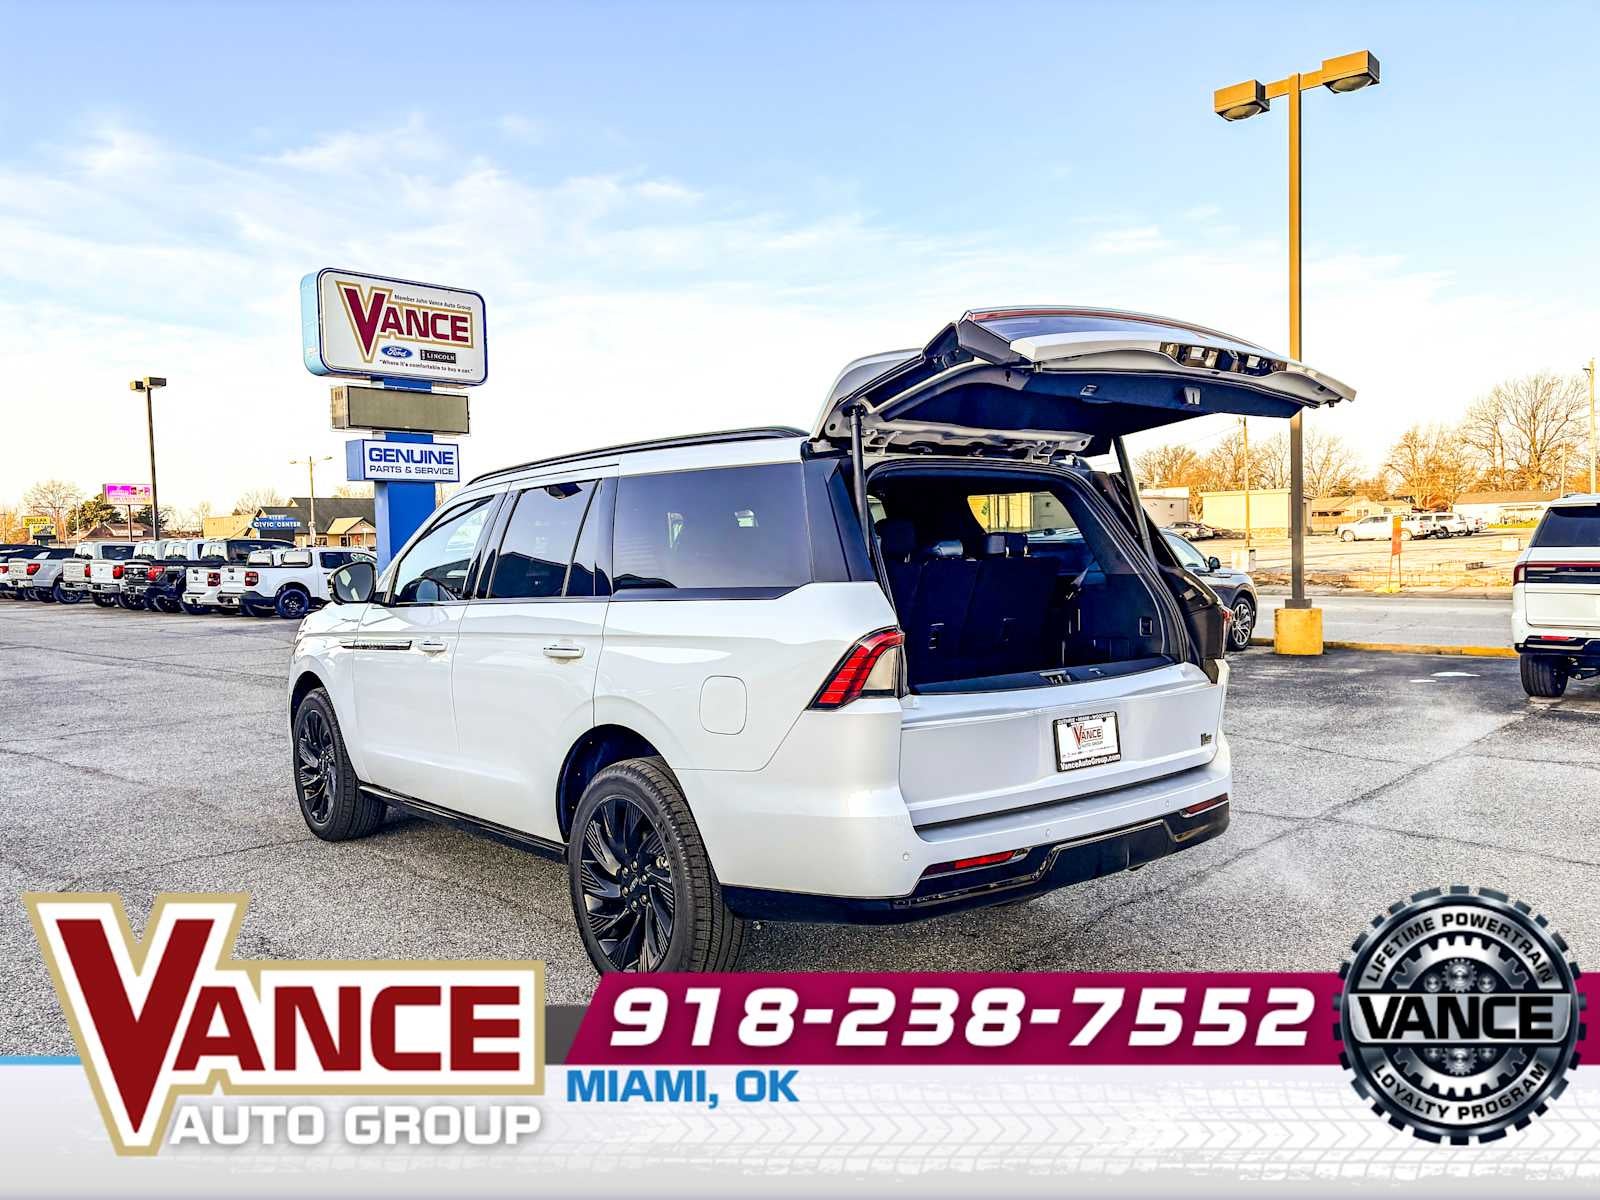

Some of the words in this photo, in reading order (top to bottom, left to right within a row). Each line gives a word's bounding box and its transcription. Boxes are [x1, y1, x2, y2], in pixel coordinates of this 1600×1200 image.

[343, 287, 469, 357] VANCE
[386, 346, 408, 358] Ford
[426, 352, 456, 361] LINCOLN
[368, 448, 454, 465] GENUINE
[370, 465, 402, 474] PARTS
[414, 466, 454, 475] SERVICE
[1073, 725, 1102, 747] VANCE
[1060, 754, 1120, 770] VanceAutoGroup.com
